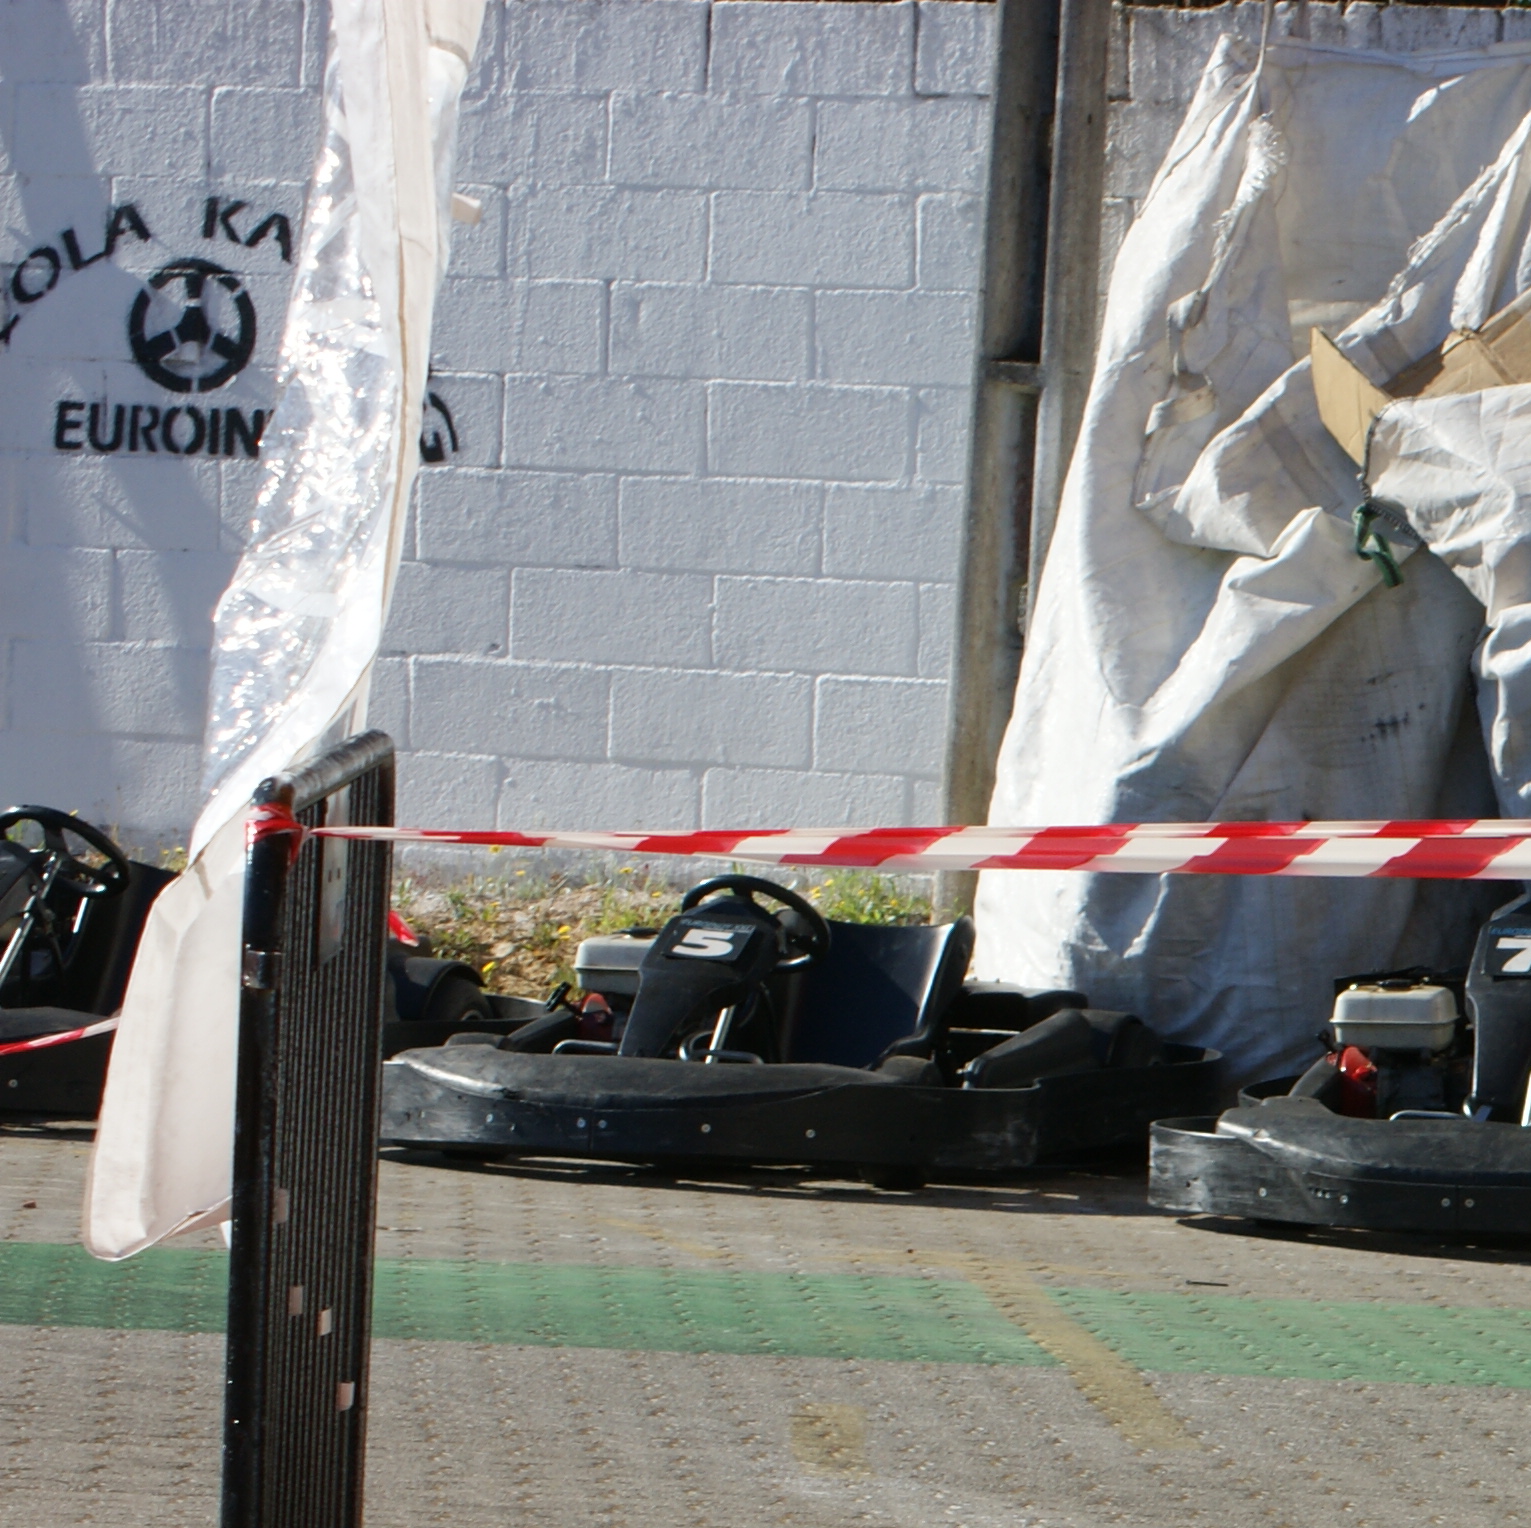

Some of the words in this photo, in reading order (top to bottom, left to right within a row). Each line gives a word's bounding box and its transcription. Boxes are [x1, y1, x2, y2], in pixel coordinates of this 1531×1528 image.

[0, 202, 152, 347] OLA
[202, 195, 293, 263] KA
[54, 400, 275, 459] EUROIN
[672, 928, 734, 957] 5
